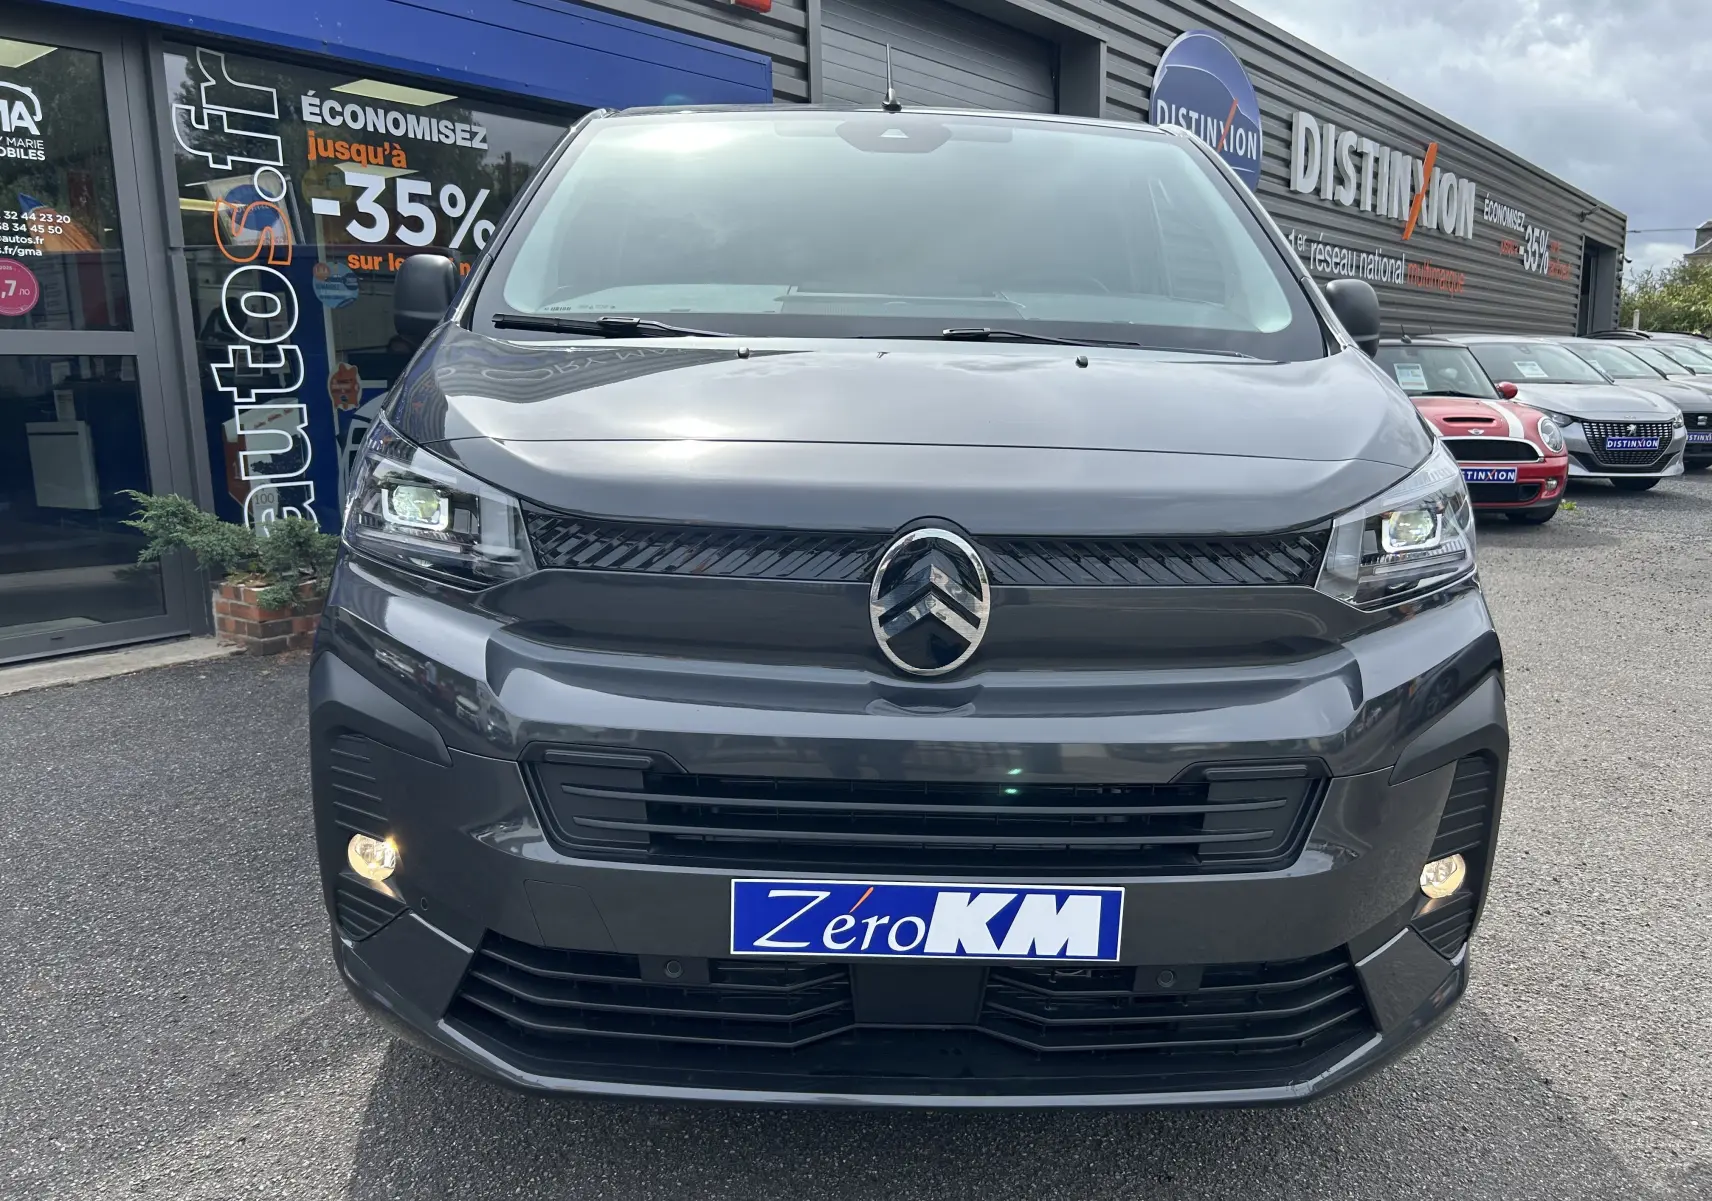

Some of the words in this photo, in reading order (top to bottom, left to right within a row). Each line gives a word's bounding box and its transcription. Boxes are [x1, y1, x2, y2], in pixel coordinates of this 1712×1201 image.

[301, 90, 488, 150] ÉCONOMISEZ
[1156, 98, 1257, 161] DISTINXION
[6, 137, 45, 150] MARIE
[308, 130, 408, 168] jusqu'à
[1289, 111, 1476, 241] DISTINXION
[4, 210, 18, 220] 32
[21, 212, 36, 221] 44
[40, 214, 53, 222] 23
[56, 215, 71, 223] 20
[12, 223, 27, 232] 34
[30, 225, 45, 233] 45
[47, 226, 63, 235] 50
[311, 171, 496, 250] -35%
[1483, 193, 1525, 232] ÉCONOMISEZ
[347, 253, 383, 271] sur
[1310, 232, 1357, 277] réseau
[1359, 248, 1405, 285] national
[1519, 224, 1550, 275] -35%
[1607, 438, 1659, 449] DISTINXION
